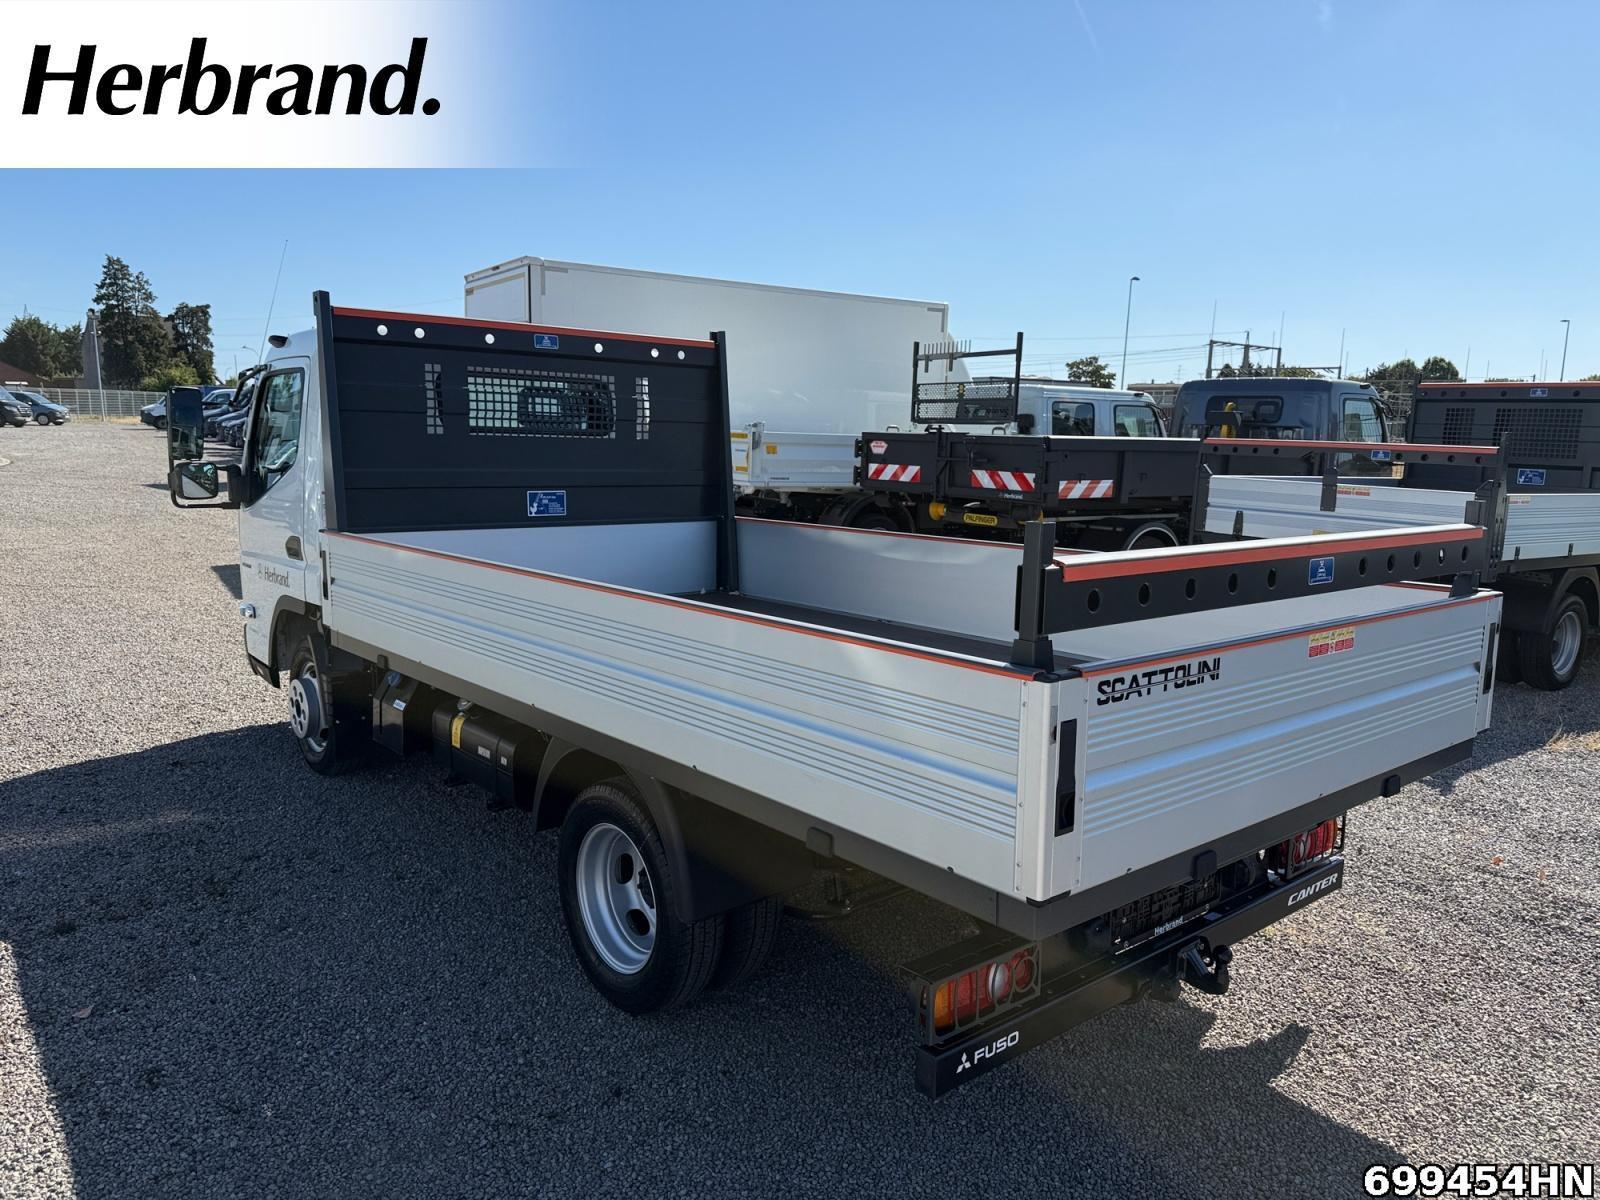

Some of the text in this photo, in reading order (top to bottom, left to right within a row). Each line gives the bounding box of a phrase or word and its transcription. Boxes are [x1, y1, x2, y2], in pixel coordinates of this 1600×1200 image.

[965, 514, 996, 525] PALFINGER
[1097, 657, 1221, 706] SCATTOLINI
[1287, 872, 1338, 907] CANTER
[974, 1030, 1019, 1065] FUSO
